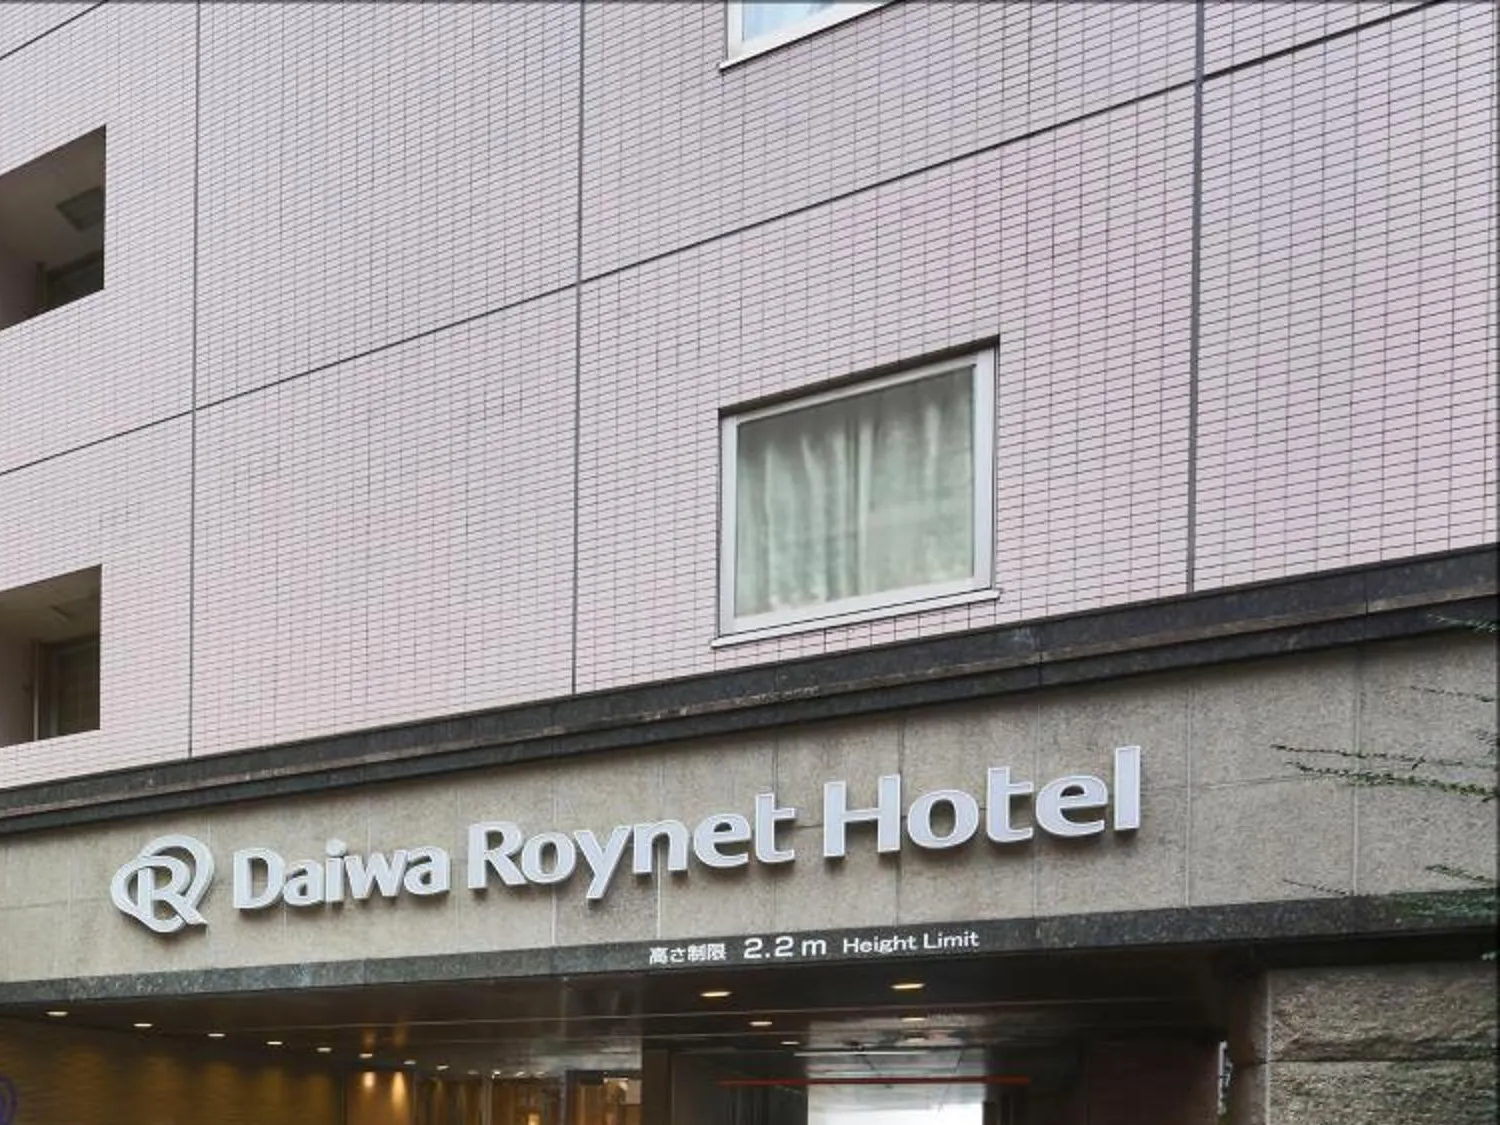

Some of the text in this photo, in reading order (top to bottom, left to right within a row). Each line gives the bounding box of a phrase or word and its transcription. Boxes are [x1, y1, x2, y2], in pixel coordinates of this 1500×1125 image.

[234, 839, 450, 909] Daiwa
[468, 792, 797, 900] Roynet
[824, 745, 1141, 858] Hotel
[649, 943, 726, 965] 高さ制限
[843, 935, 917, 954] Height
[923, 931, 980, 949] Limit
